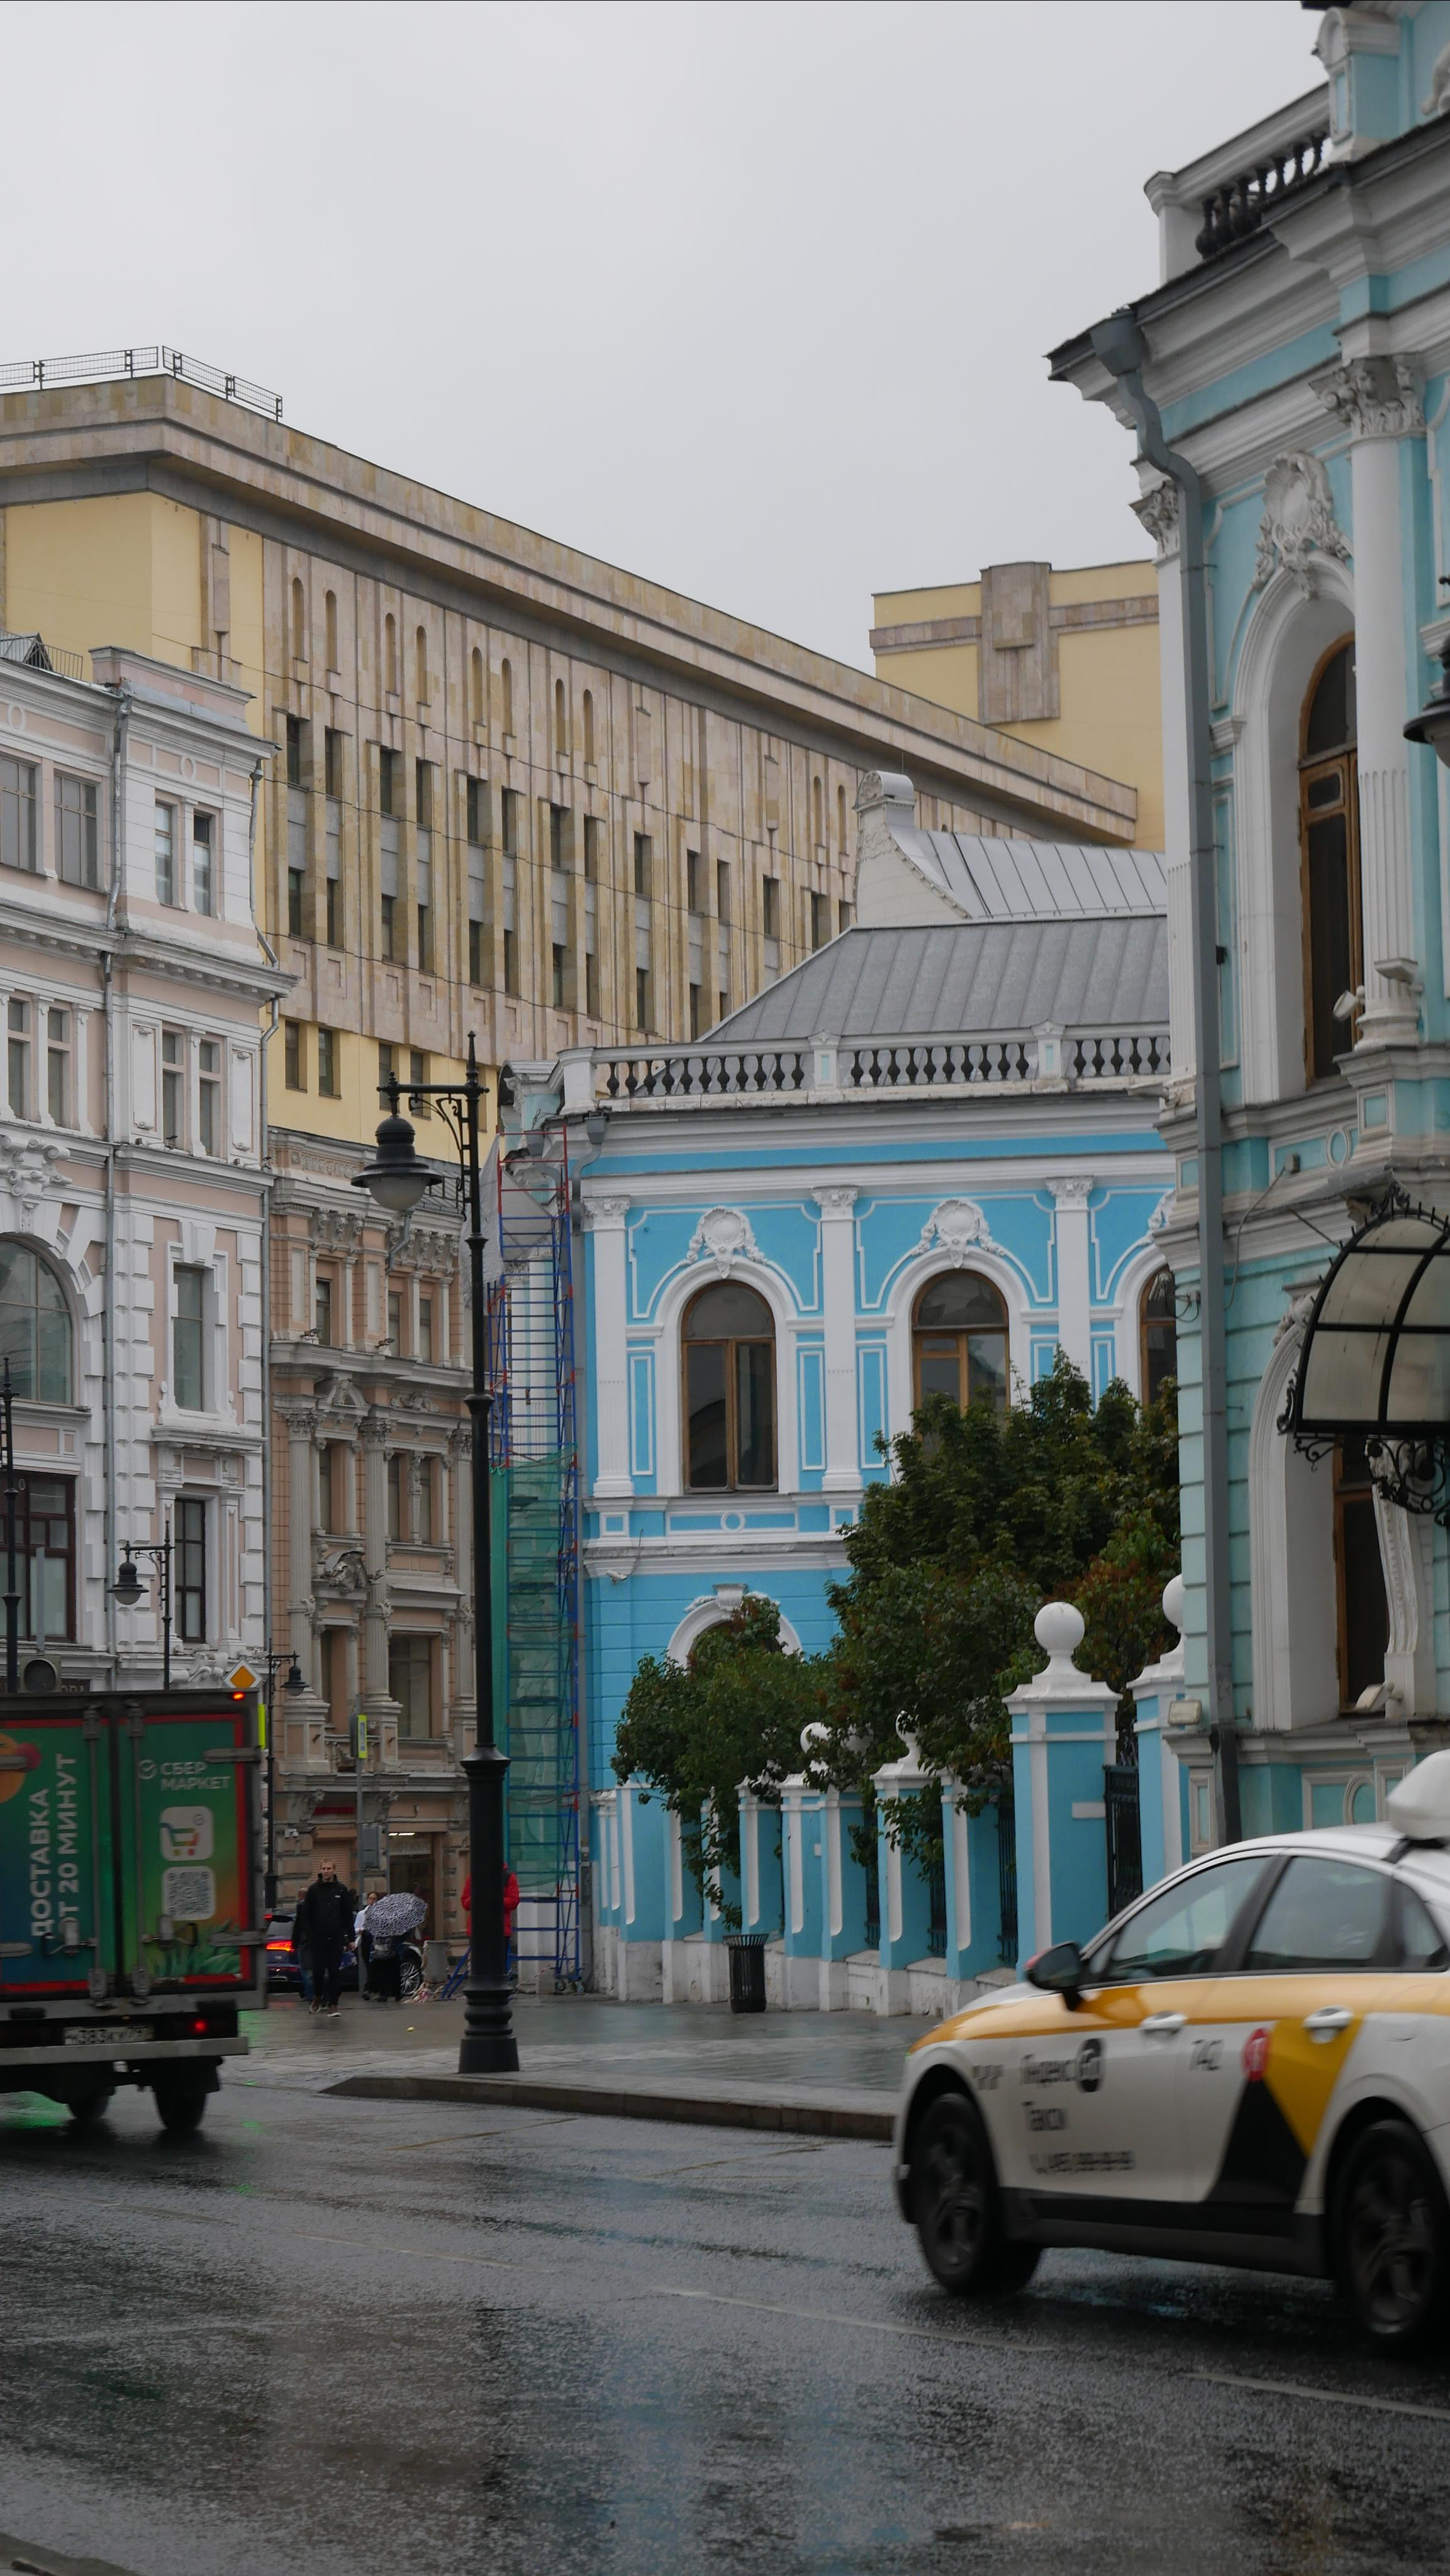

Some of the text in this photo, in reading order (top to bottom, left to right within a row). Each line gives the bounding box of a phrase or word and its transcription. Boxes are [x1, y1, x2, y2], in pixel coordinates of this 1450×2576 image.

[160, 1761, 207, 1775] СБЕР
[160, 1775, 231, 1791] МАРКЕТ
[29, 1788, 55, 1939] ДОСТАВКА
[55, 1753, 80, 1935] Т 20 МИНУТ
